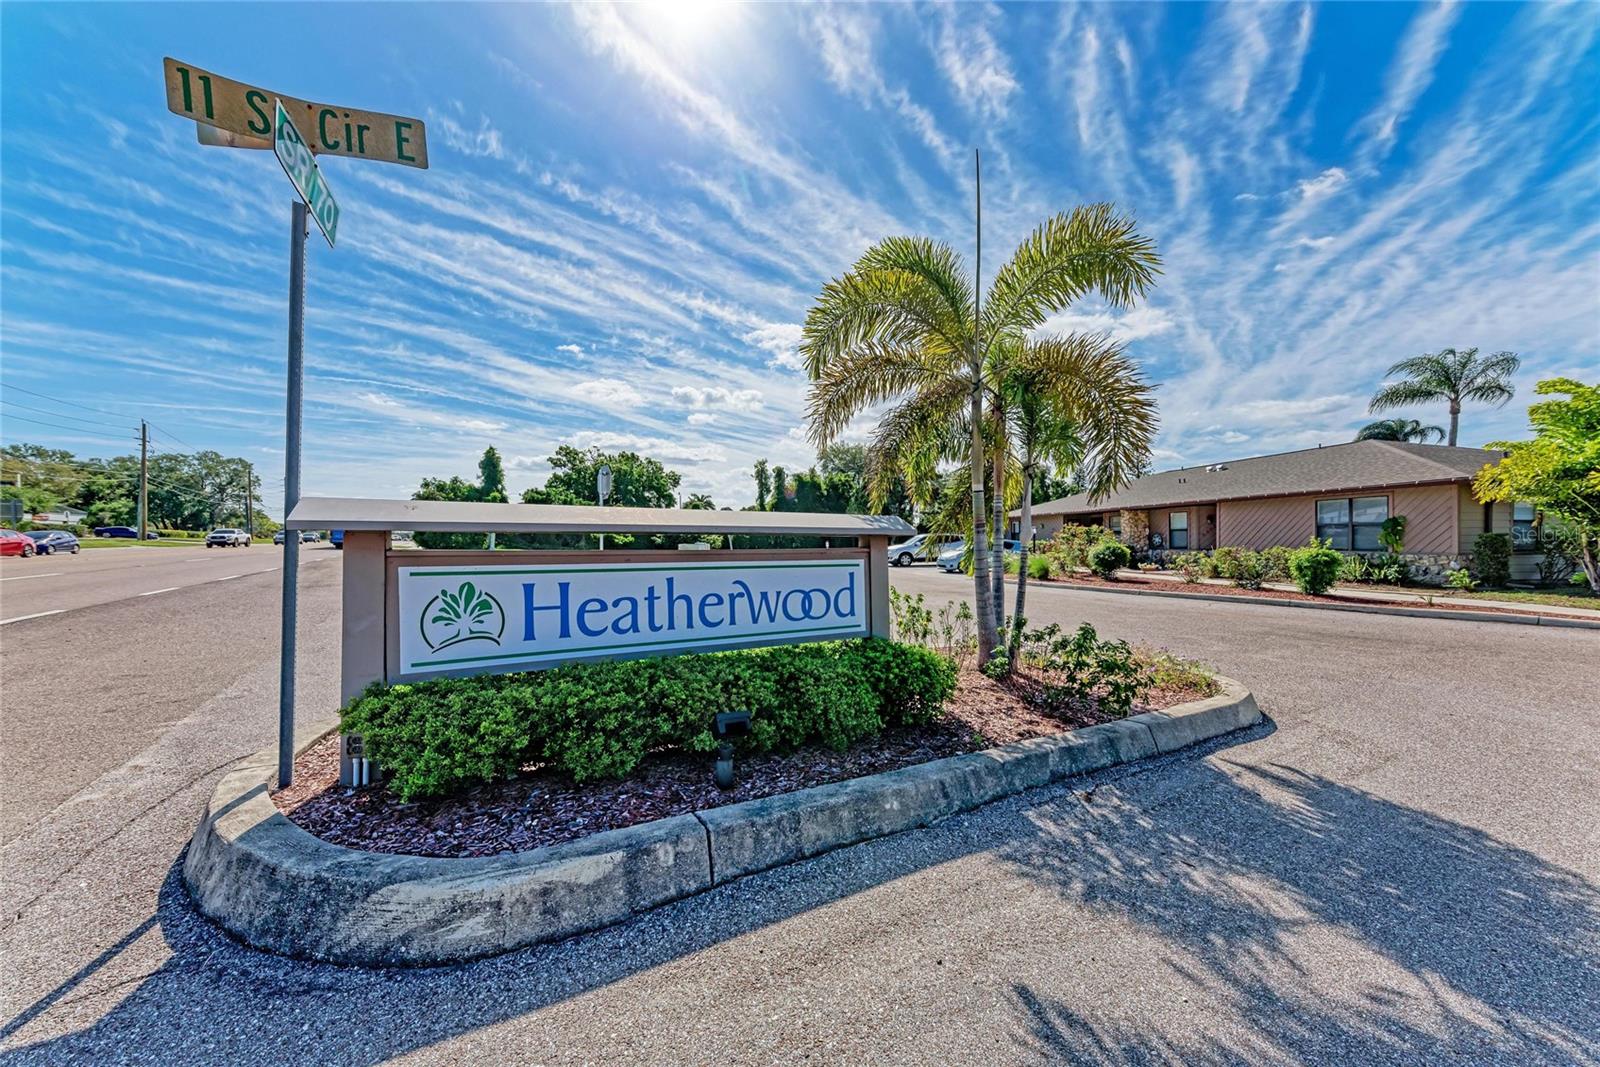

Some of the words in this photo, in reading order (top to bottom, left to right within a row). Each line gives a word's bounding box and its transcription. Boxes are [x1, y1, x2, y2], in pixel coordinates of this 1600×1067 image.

[176, 67, 214, 120] 11
[246, 90, 289, 136] S
[319, 109, 370, 154] Cir
[395, 121, 416, 162] E
[315, 172, 335, 231] 70
[522, 572, 855, 641] Heatherwood
